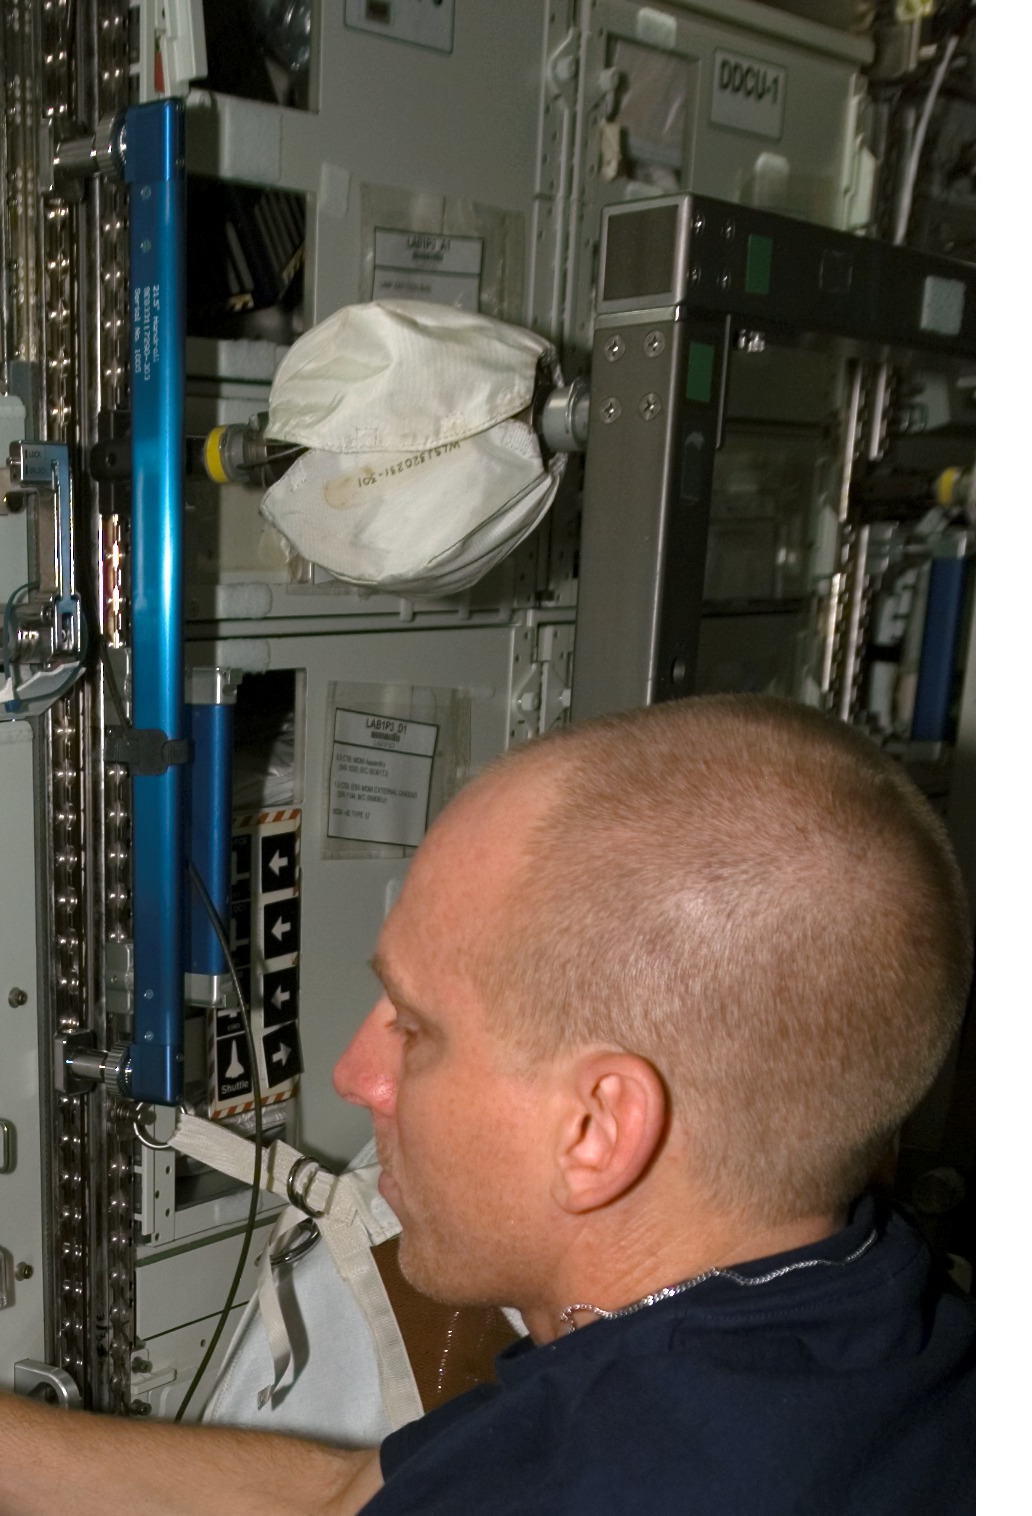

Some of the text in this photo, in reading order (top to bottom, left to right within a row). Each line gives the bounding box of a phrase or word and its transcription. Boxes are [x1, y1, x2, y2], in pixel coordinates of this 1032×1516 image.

[720, 59, 779, 104] DDCU-1
[365, 718, 408, 735] LAB1P3 D1
[220, 1078, 250, 1096] Shuttle
